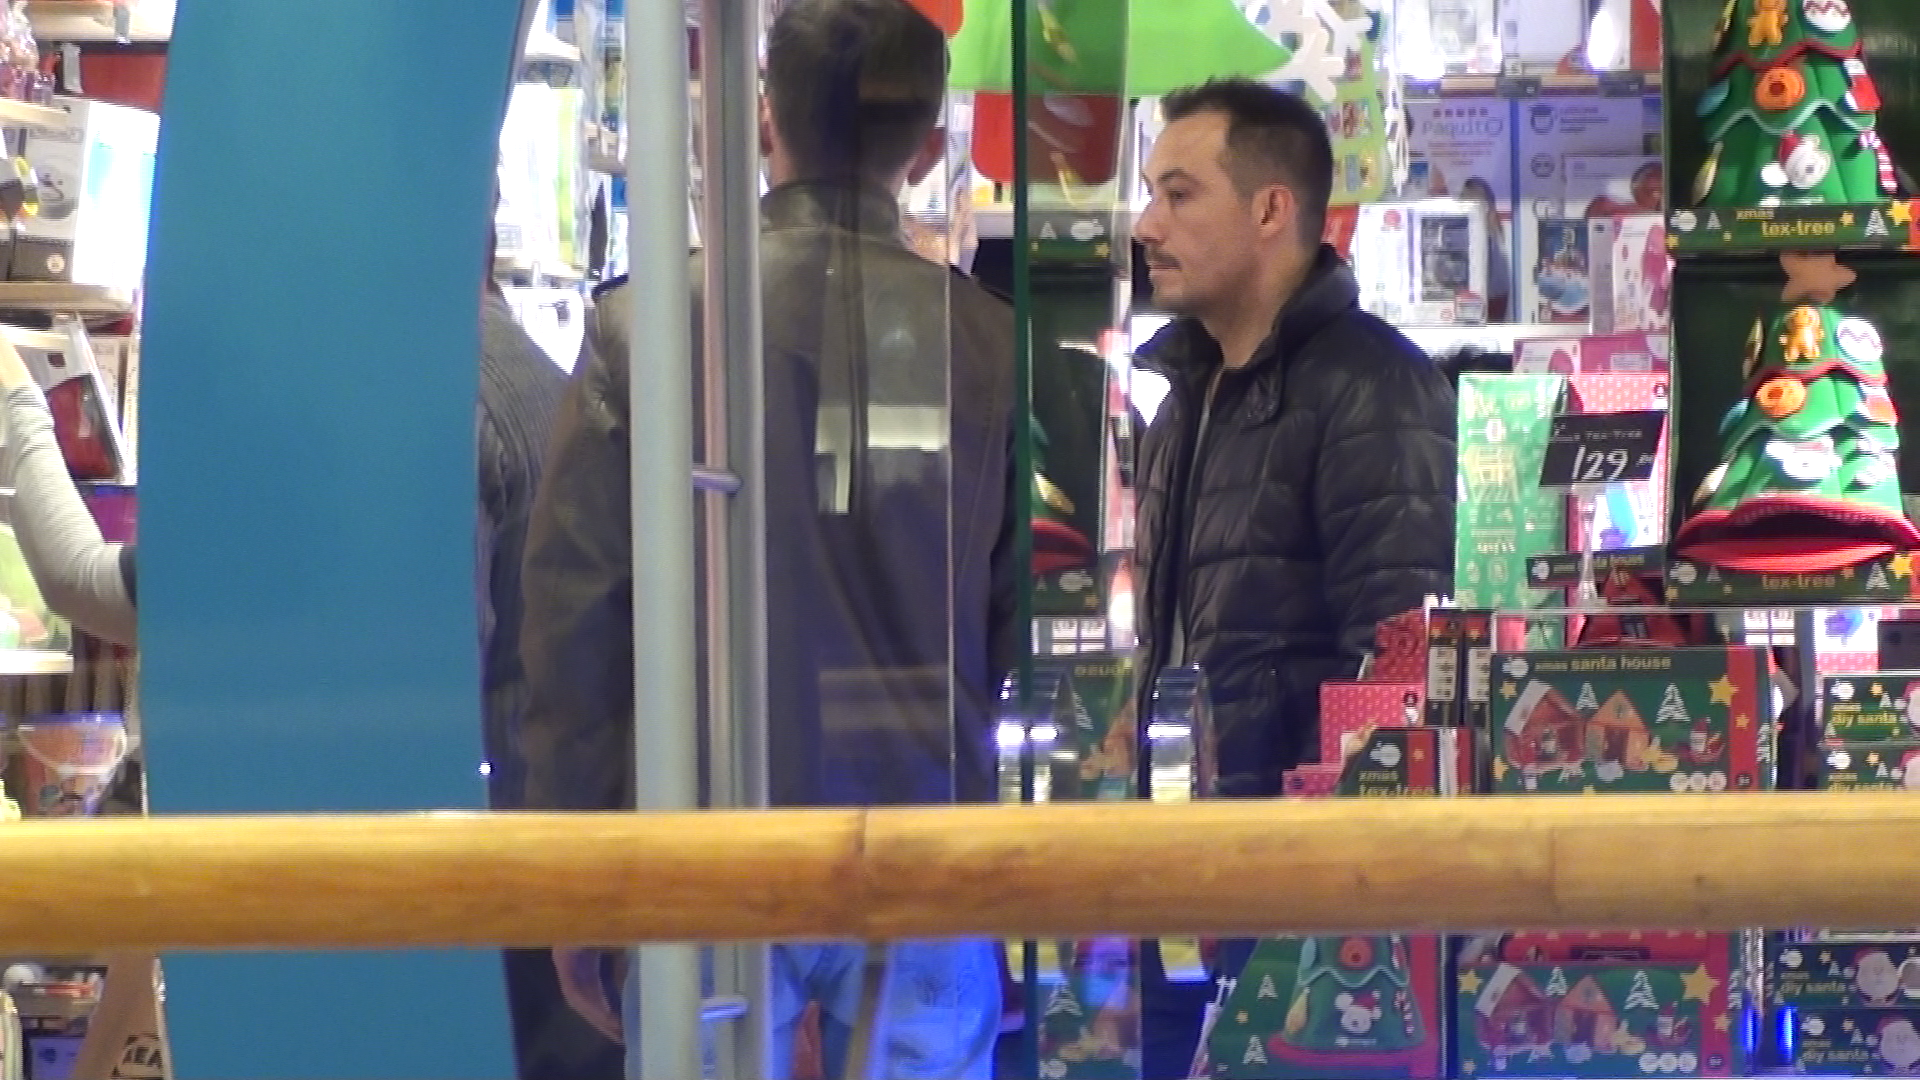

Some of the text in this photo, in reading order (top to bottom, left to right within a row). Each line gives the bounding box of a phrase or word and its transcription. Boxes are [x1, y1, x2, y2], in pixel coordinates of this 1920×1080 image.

[1761, 219, 1836, 236] tex-tree
[1762, 573, 1836, 590] tex-tree
[1570, 656, 1617, 672] santa
[1620, 655, 1672, 670] house
[1857, 711, 1897, 725] santa
[1804, 981, 1846, 993] santa
[1827, 1048, 1869, 1062] santa
